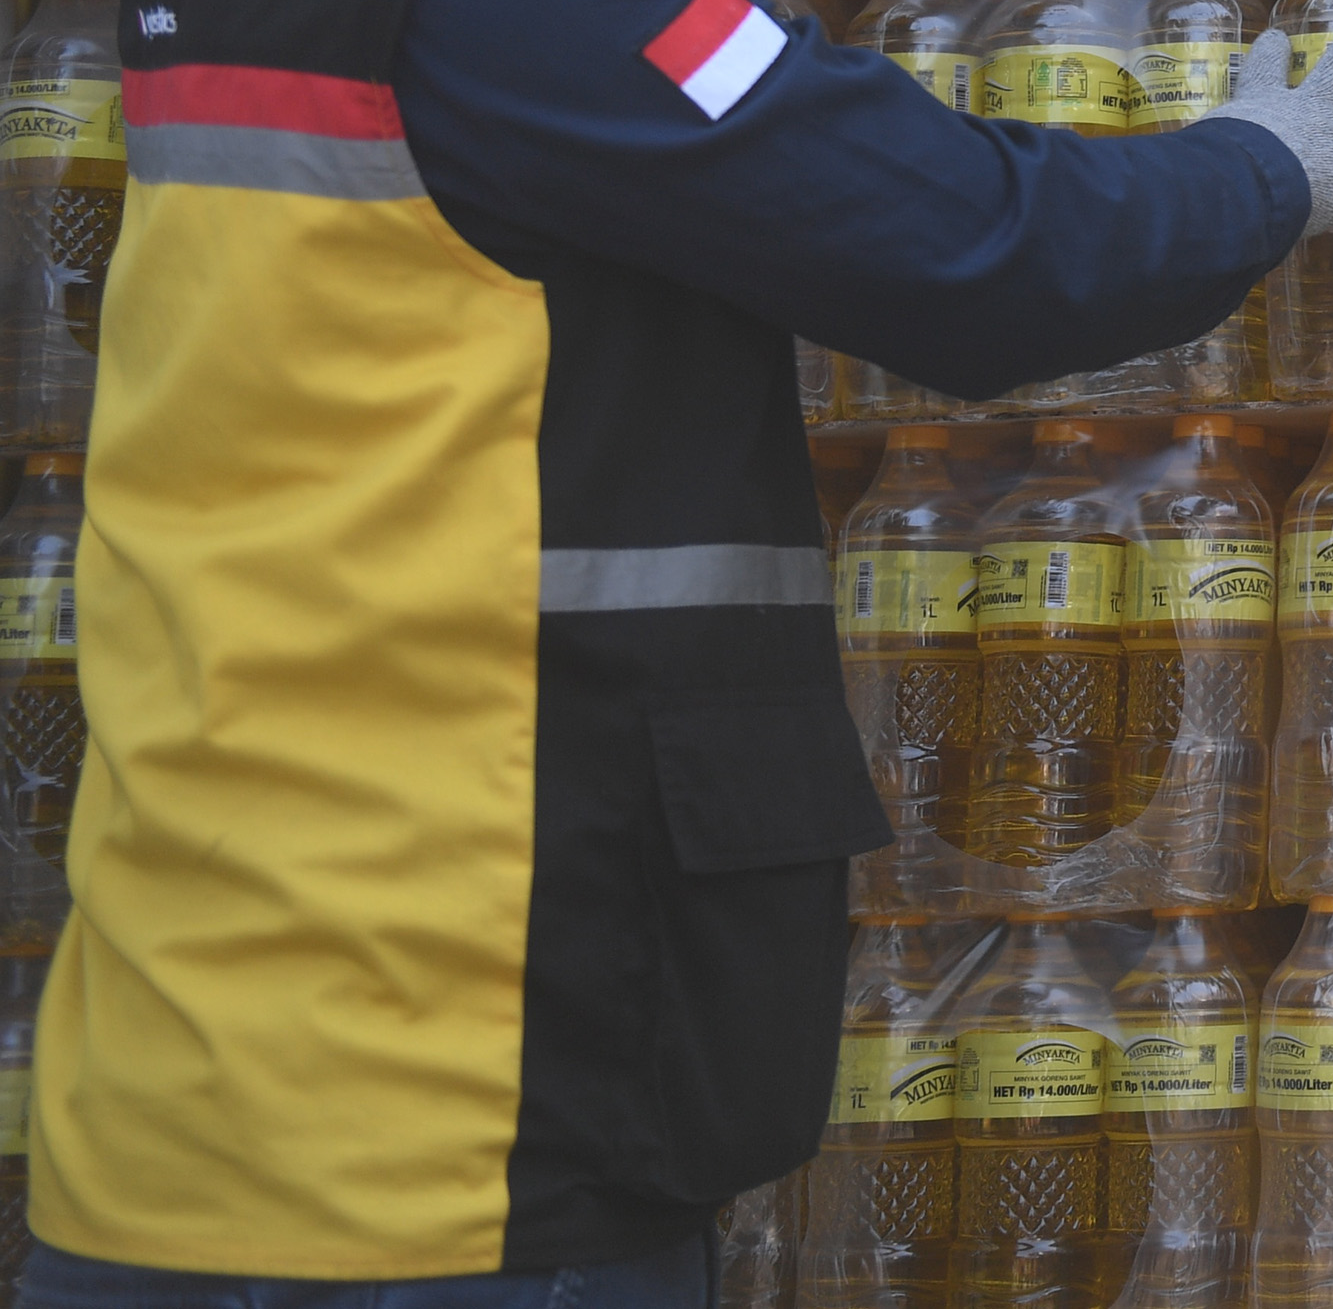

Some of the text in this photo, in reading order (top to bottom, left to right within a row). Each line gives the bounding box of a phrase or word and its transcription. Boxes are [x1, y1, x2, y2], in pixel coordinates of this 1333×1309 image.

[1102, 95, 1118, 107] HET
[1320, 582, 1332, 594] Rp
[1024, 1049, 1081, 1066] MINYAKITA
[994, 1083, 1099, 1098] HET Rp 14.000/Liter
[1125, 1079, 1212, 1093] Rp 14.000/Liter
